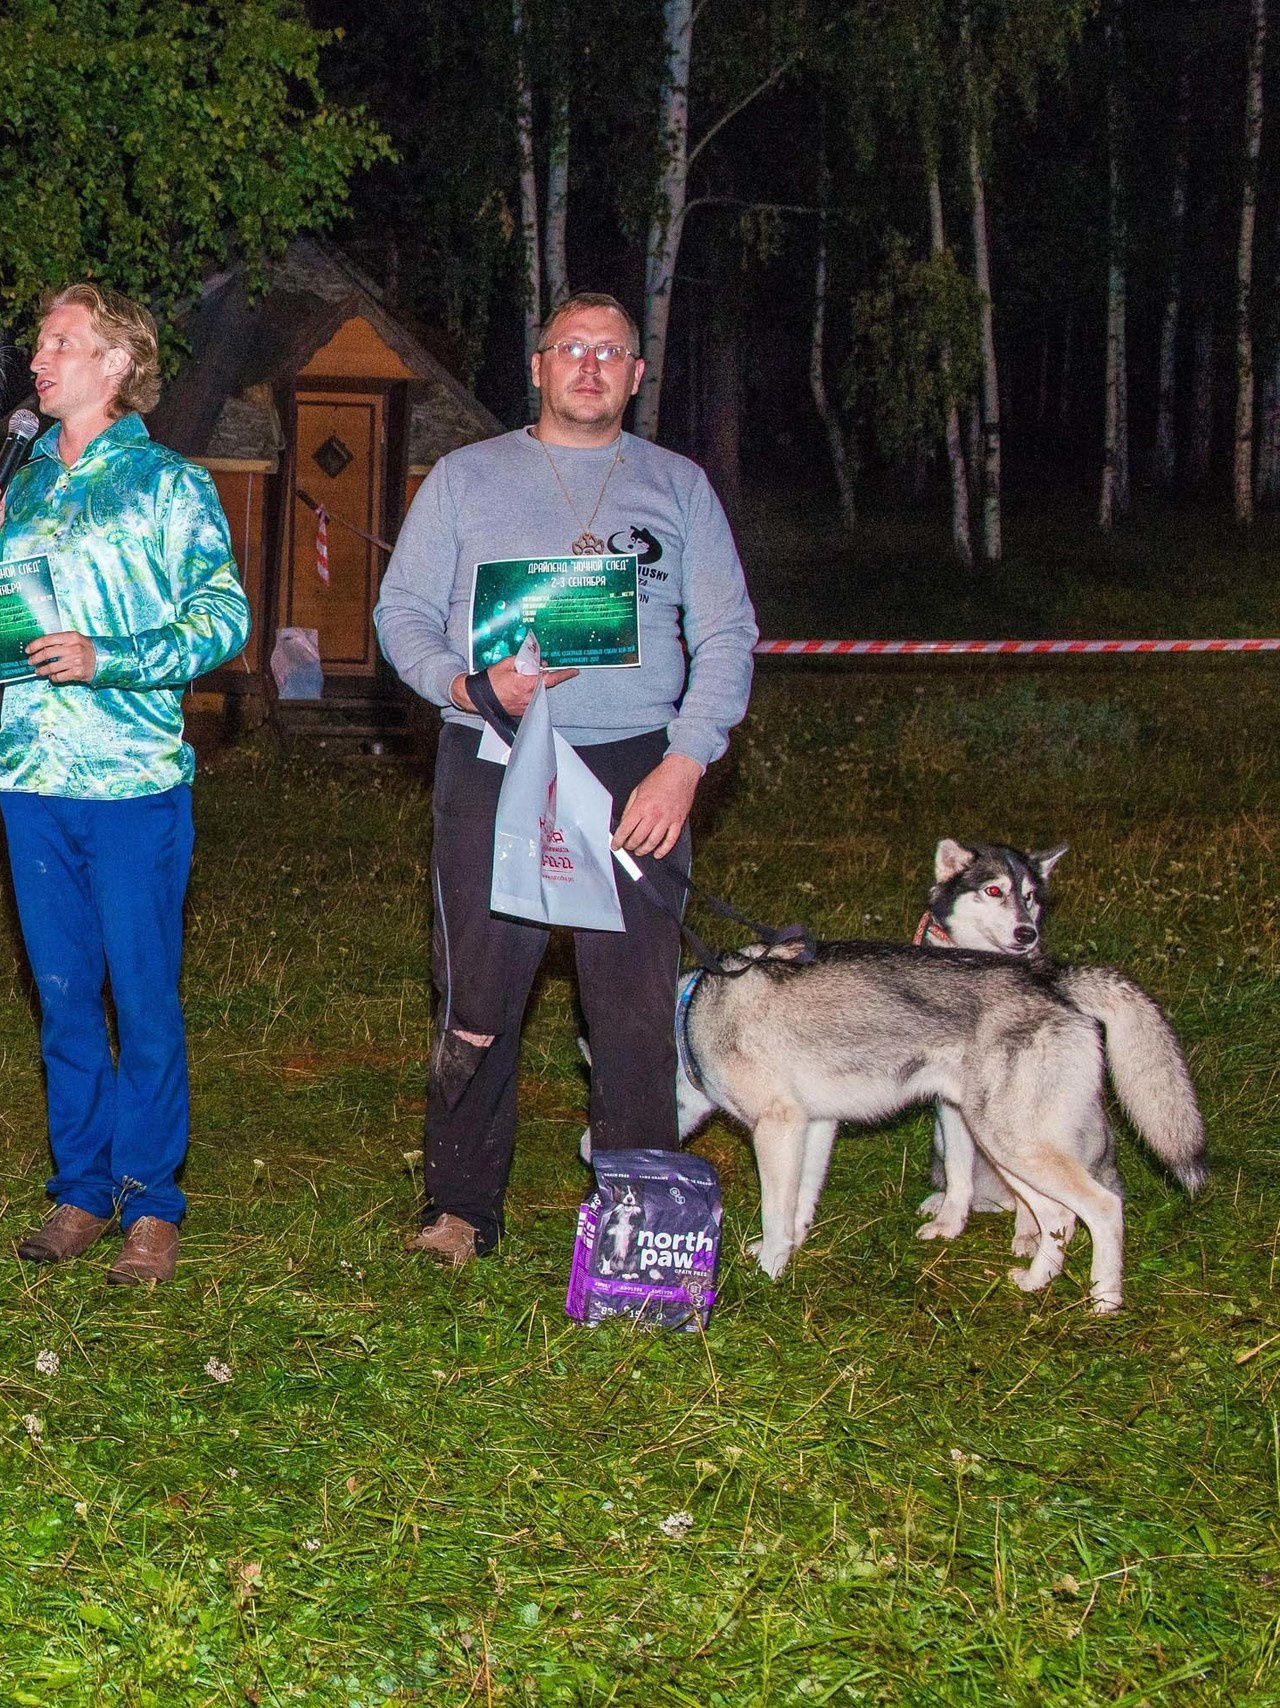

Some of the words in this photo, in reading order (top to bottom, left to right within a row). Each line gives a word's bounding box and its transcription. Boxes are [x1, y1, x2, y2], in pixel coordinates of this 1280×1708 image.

[528, 561, 567, 574] ДРАЙЛЕНД
[551, 577, 566, 588] 2-3
[568, 576, 606, 588] СЕНТЯБРЯ
[637, 1230, 714, 1252] north
[640, 1248, 693, 1271] paw
